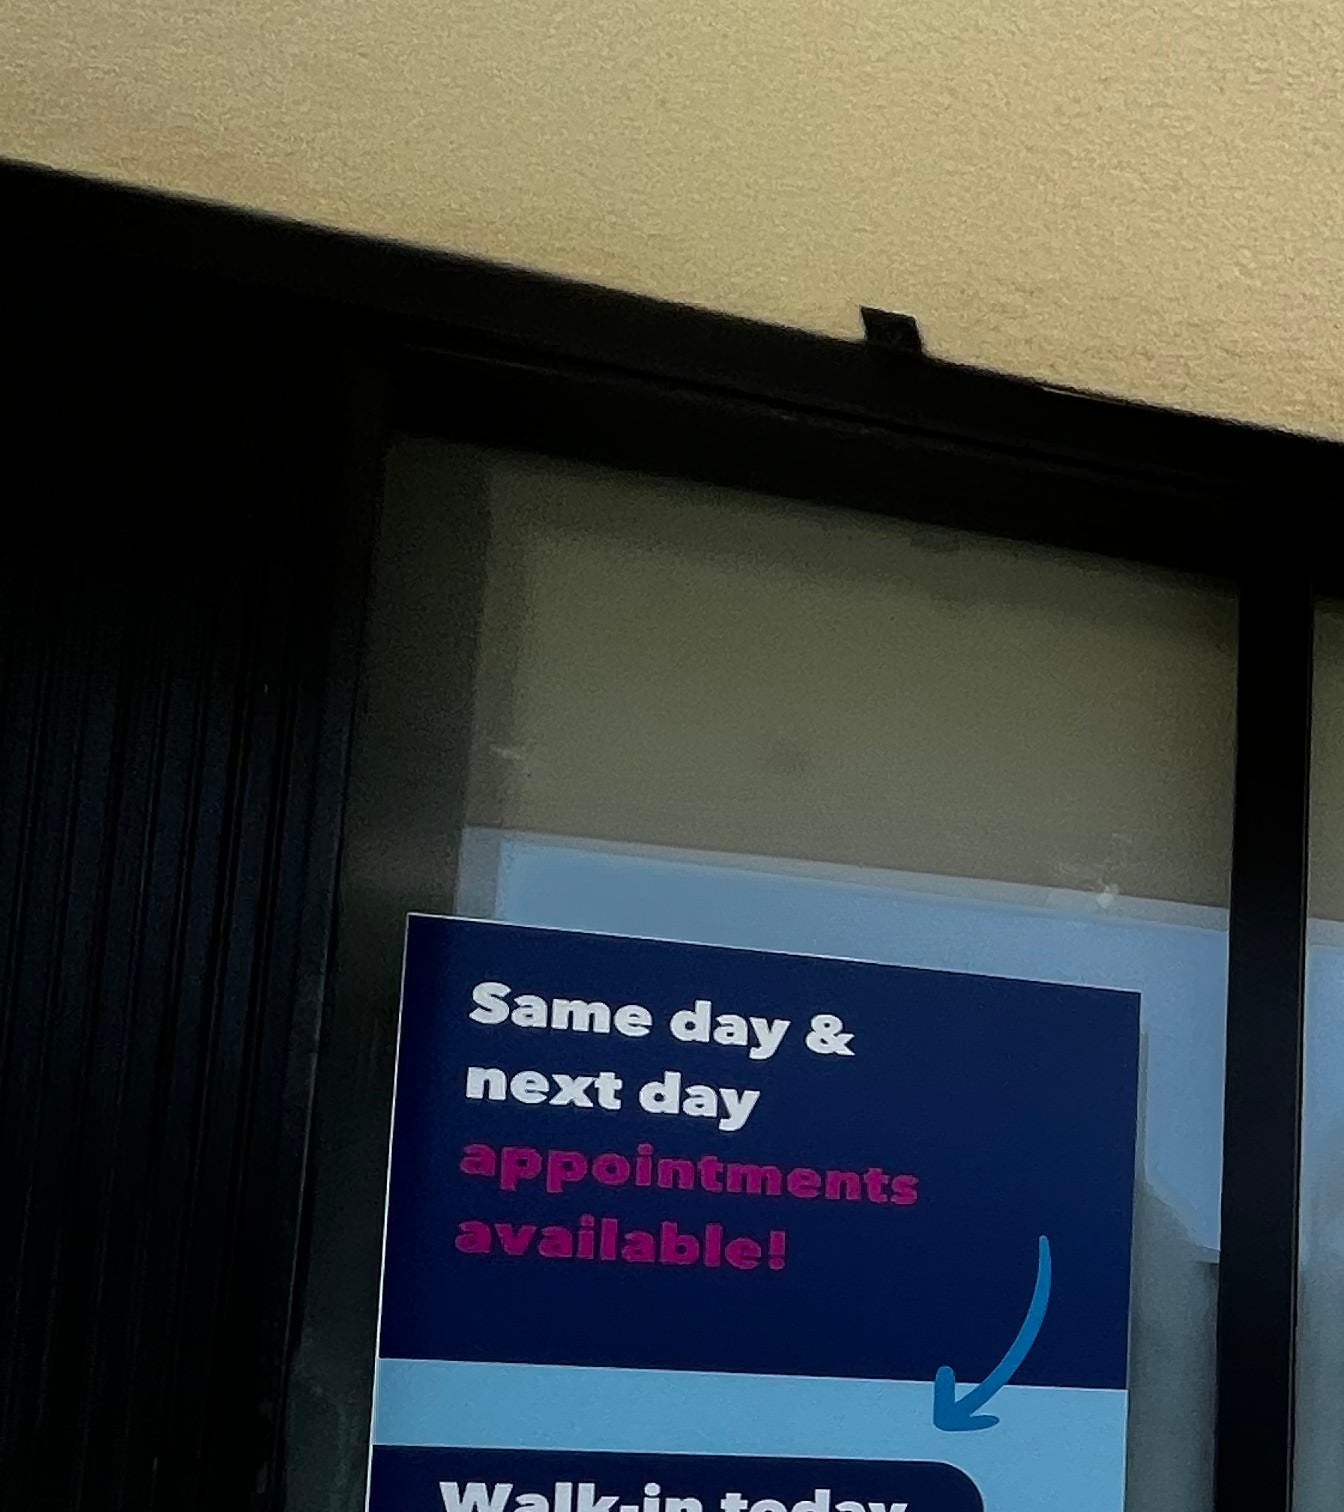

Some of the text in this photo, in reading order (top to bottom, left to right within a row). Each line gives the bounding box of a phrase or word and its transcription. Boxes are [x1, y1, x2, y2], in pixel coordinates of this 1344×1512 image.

[469, 982, 855, 1060] Same day &
[465, 1064, 761, 1131] next day
[459, 1143, 919, 1205] appointments
[455, 1214, 787, 1271] available!
